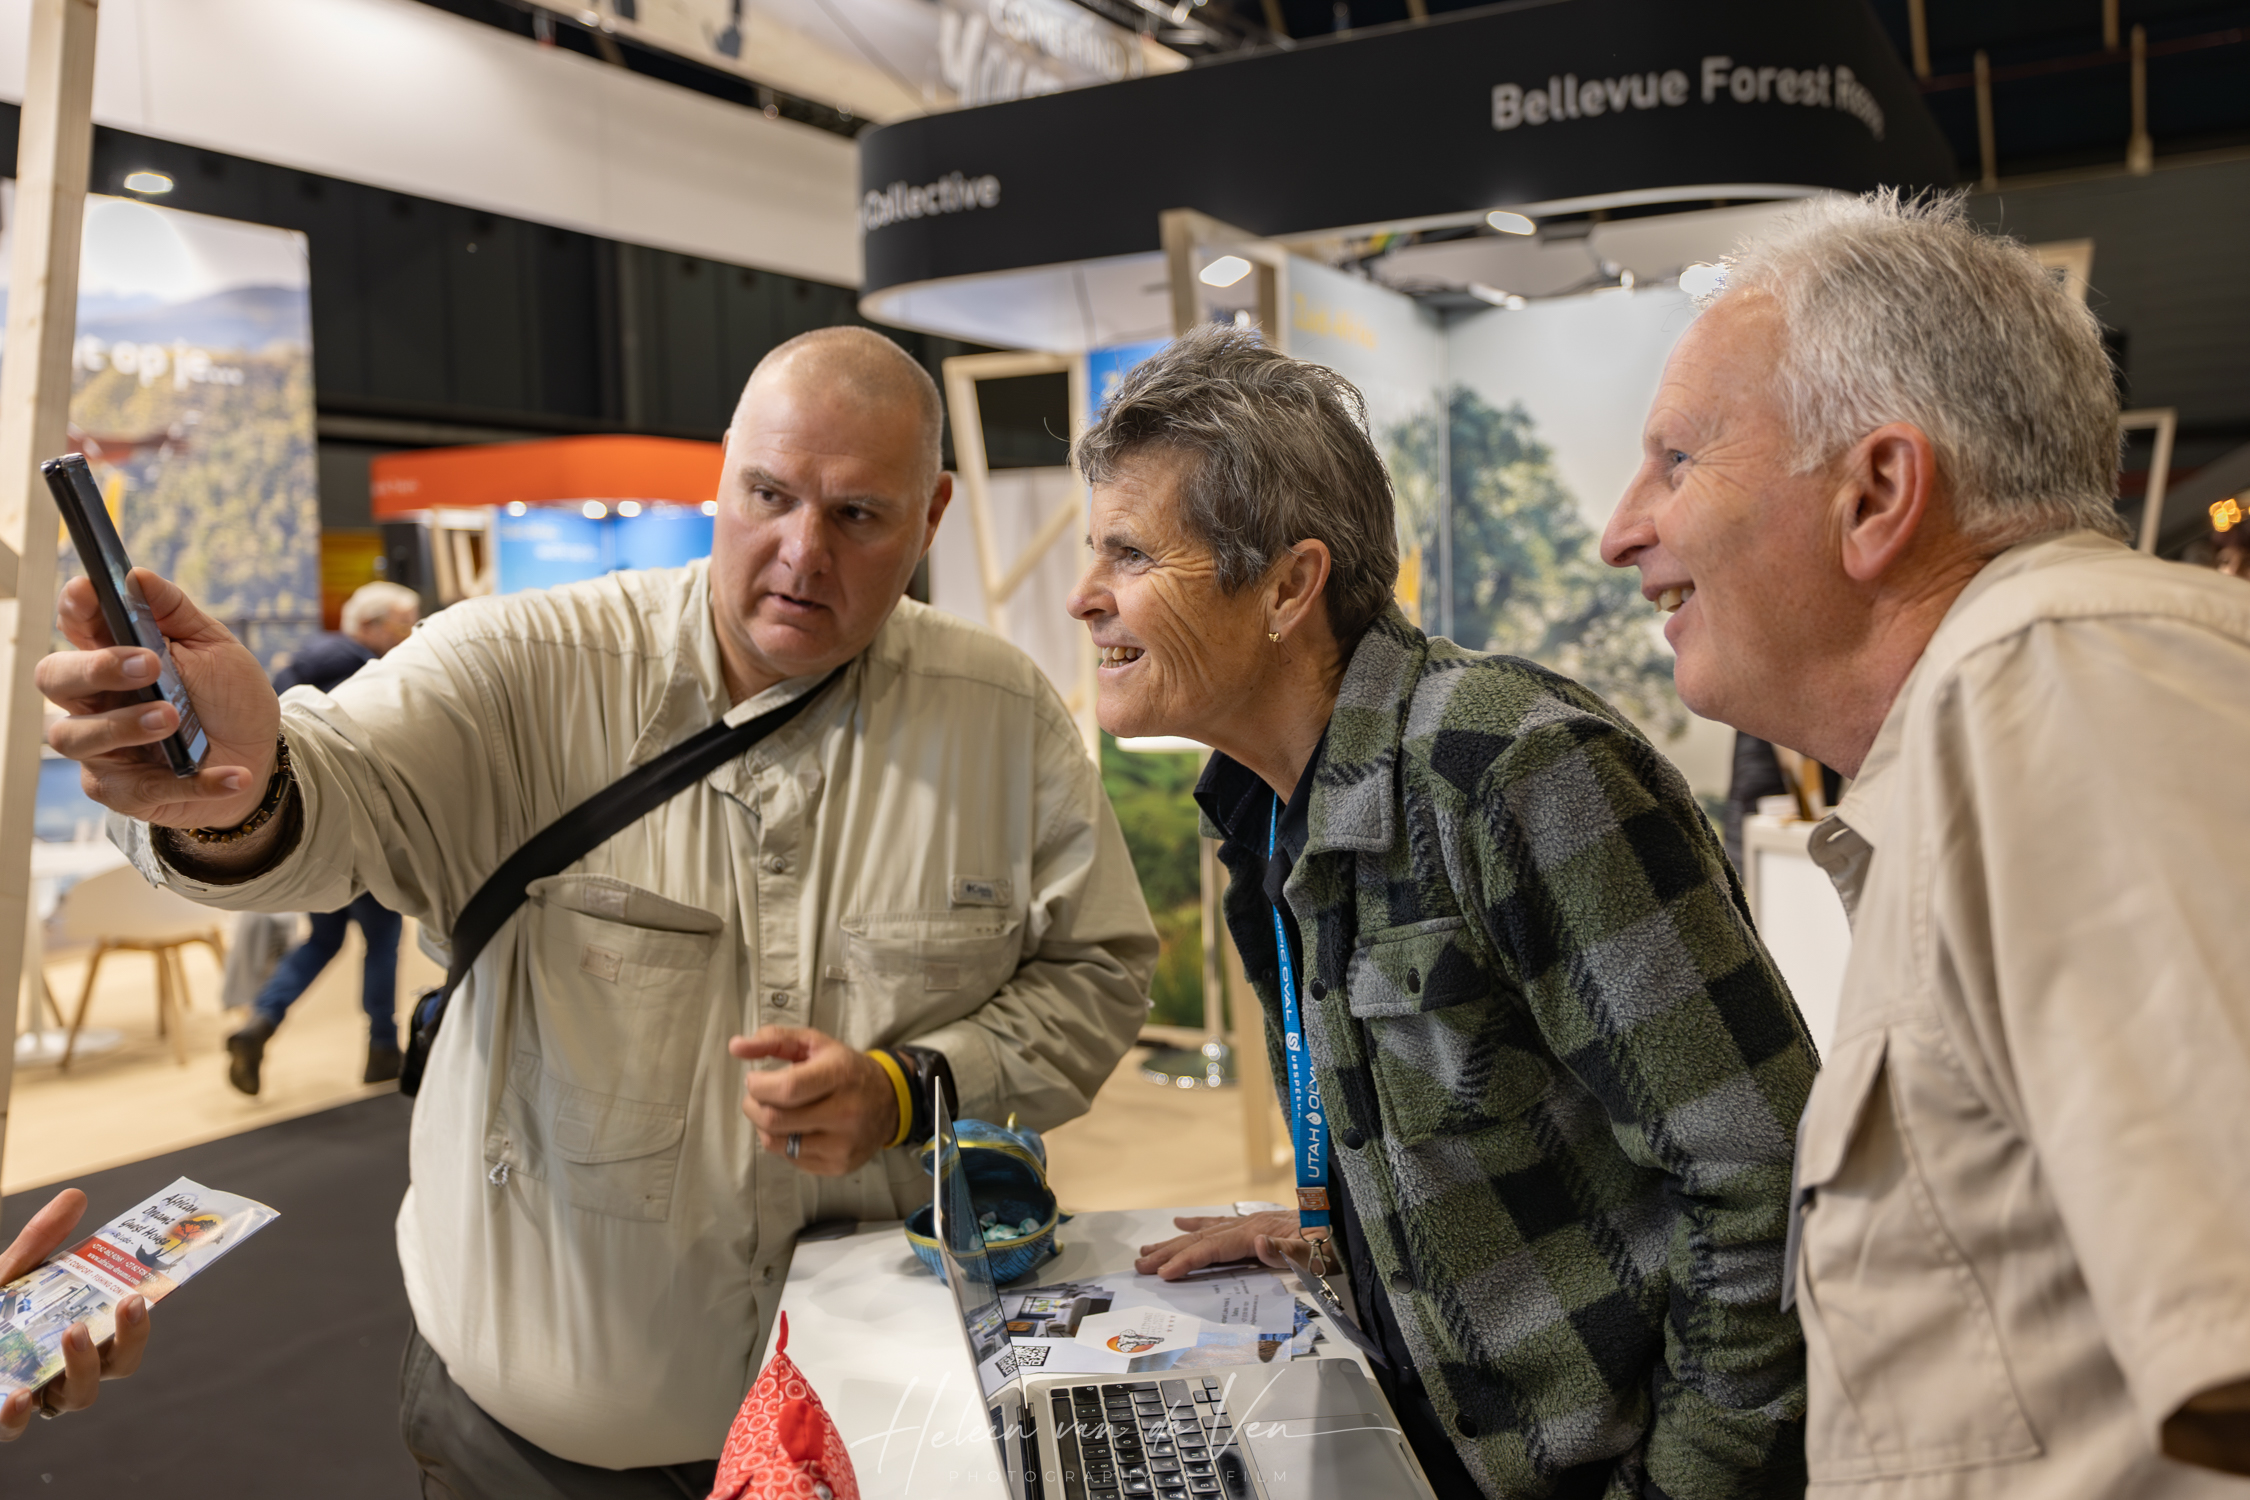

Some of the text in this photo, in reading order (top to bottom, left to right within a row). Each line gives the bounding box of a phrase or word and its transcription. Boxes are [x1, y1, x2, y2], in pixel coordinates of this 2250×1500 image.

[1491, 69, 1691, 131] Bellevue
[1701, 55, 1831, 108] Forest
[1275, 912, 1293, 1022] MPIC OVAL
[1307, 1066, 1320, 1110] OLY
[1307, 1127, 1320, 1179] UTAH
[118, 1217, 151, 1234] Guest
[161, 1193, 199, 1215] African
